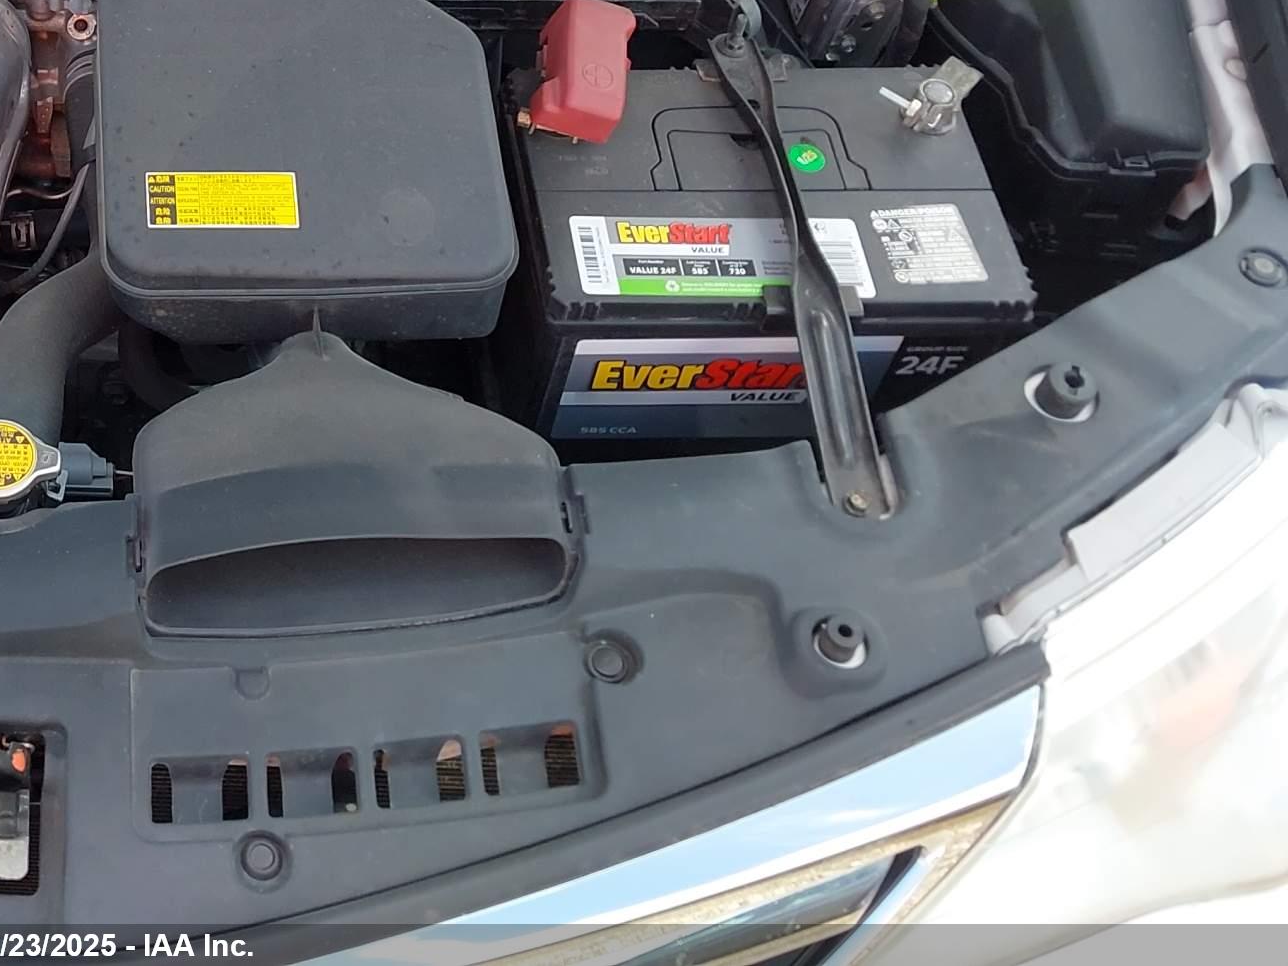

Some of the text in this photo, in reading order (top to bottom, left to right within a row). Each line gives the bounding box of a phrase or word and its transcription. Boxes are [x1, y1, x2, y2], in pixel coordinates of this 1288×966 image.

[150, 185, 175, 193] CAUTION
[616, 220, 730, 245] EverStart
[691, 246, 726, 255] VALUE
[629, 266, 659, 275] VALUE
[895, 355, 965, 375] 24F
[591, 357, 805, 392] EverStar
[730, 391, 800, 402] VALUE
